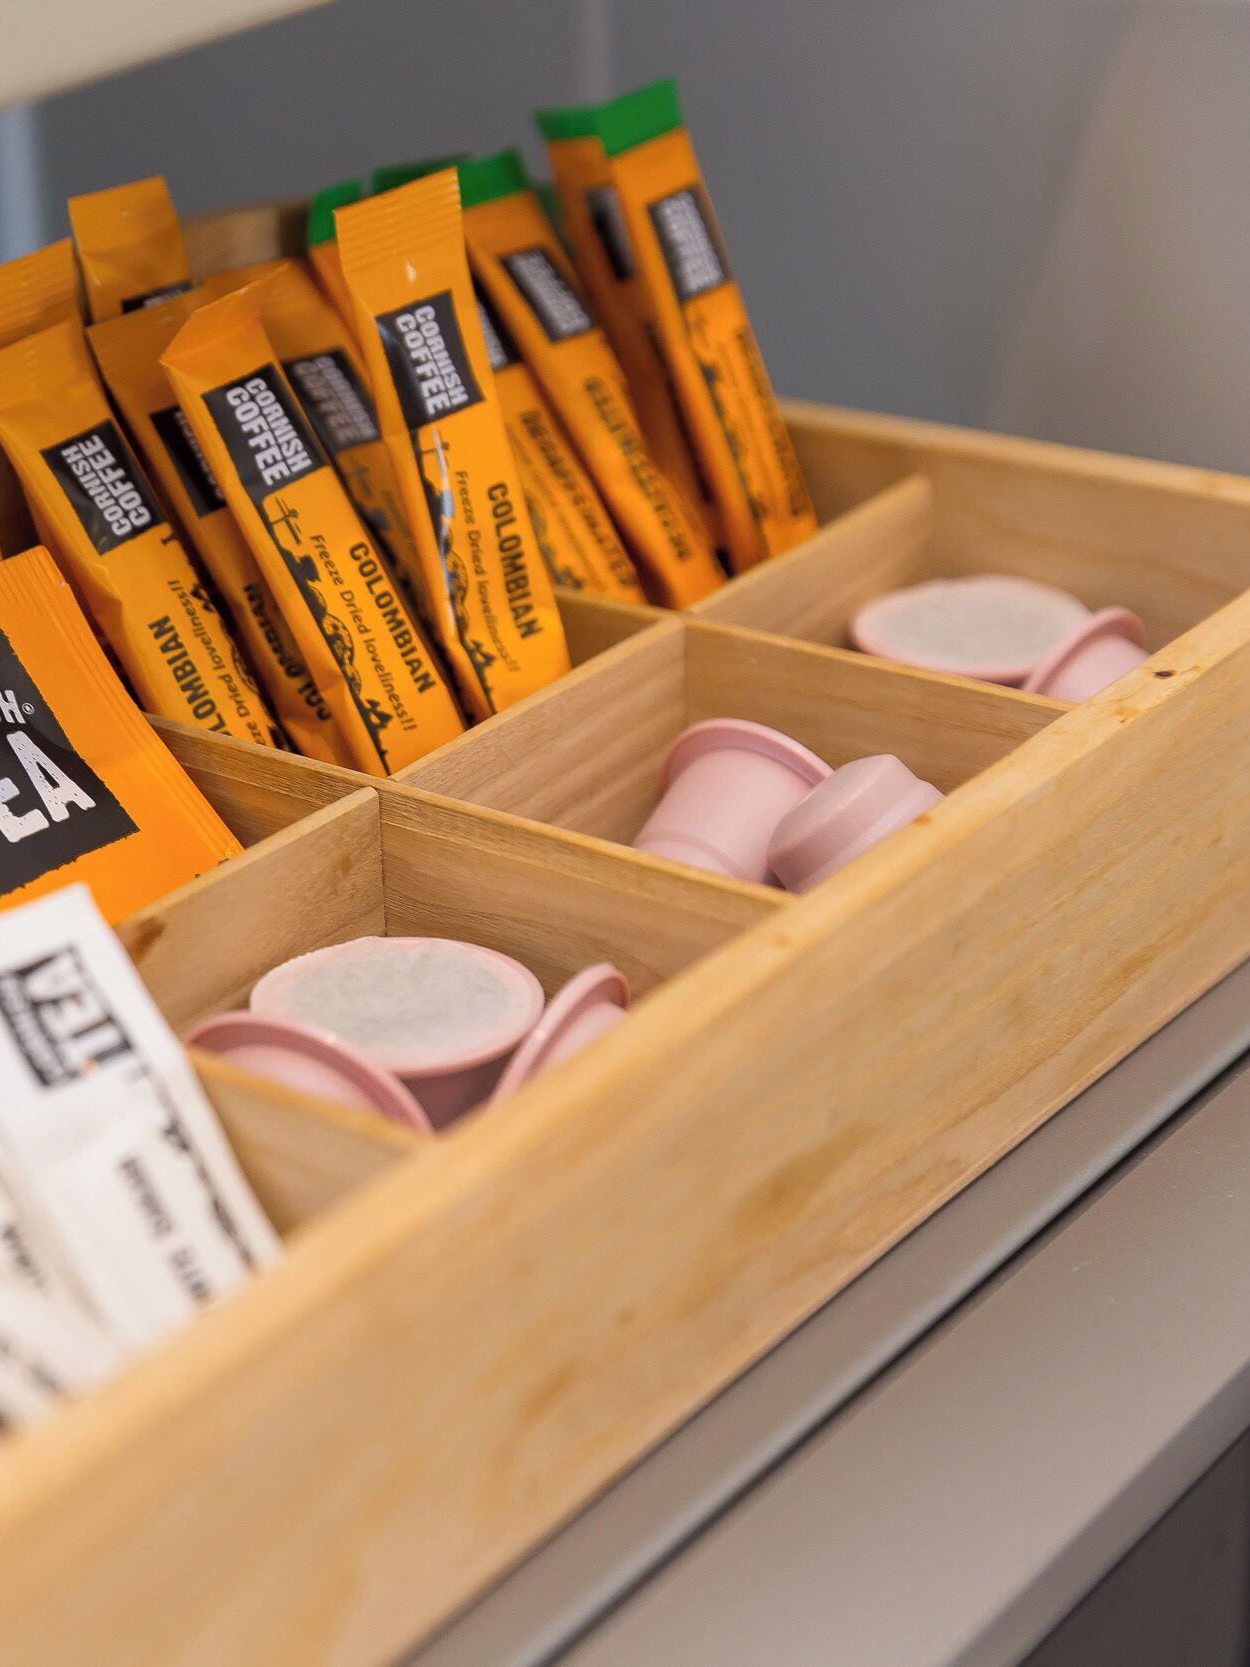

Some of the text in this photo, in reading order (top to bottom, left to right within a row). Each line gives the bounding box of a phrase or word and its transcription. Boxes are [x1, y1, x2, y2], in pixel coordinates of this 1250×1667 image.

[396, 313, 450, 415] COFFEE
[415, 305, 469, 405] CORNISH
[226, 387, 290, 486] COFFEE
[245, 377, 312, 473] CORNISH
[60, 445, 132, 536] CORNISH
[79, 434, 151, 527] COFFEE
[468, 529, 489, 576] Dried
[488, 482, 544, 639] COLOMBIAN
[167, 579, 225, 671] loveliness!!
[310, 533, 419, 732] Freeze Dried loveliness!!
[350, 542, 437, 694] COLOMBIAN
[147, 614, 233, 737] LOMBIAN
[218, 673, 251, 718] Dried
